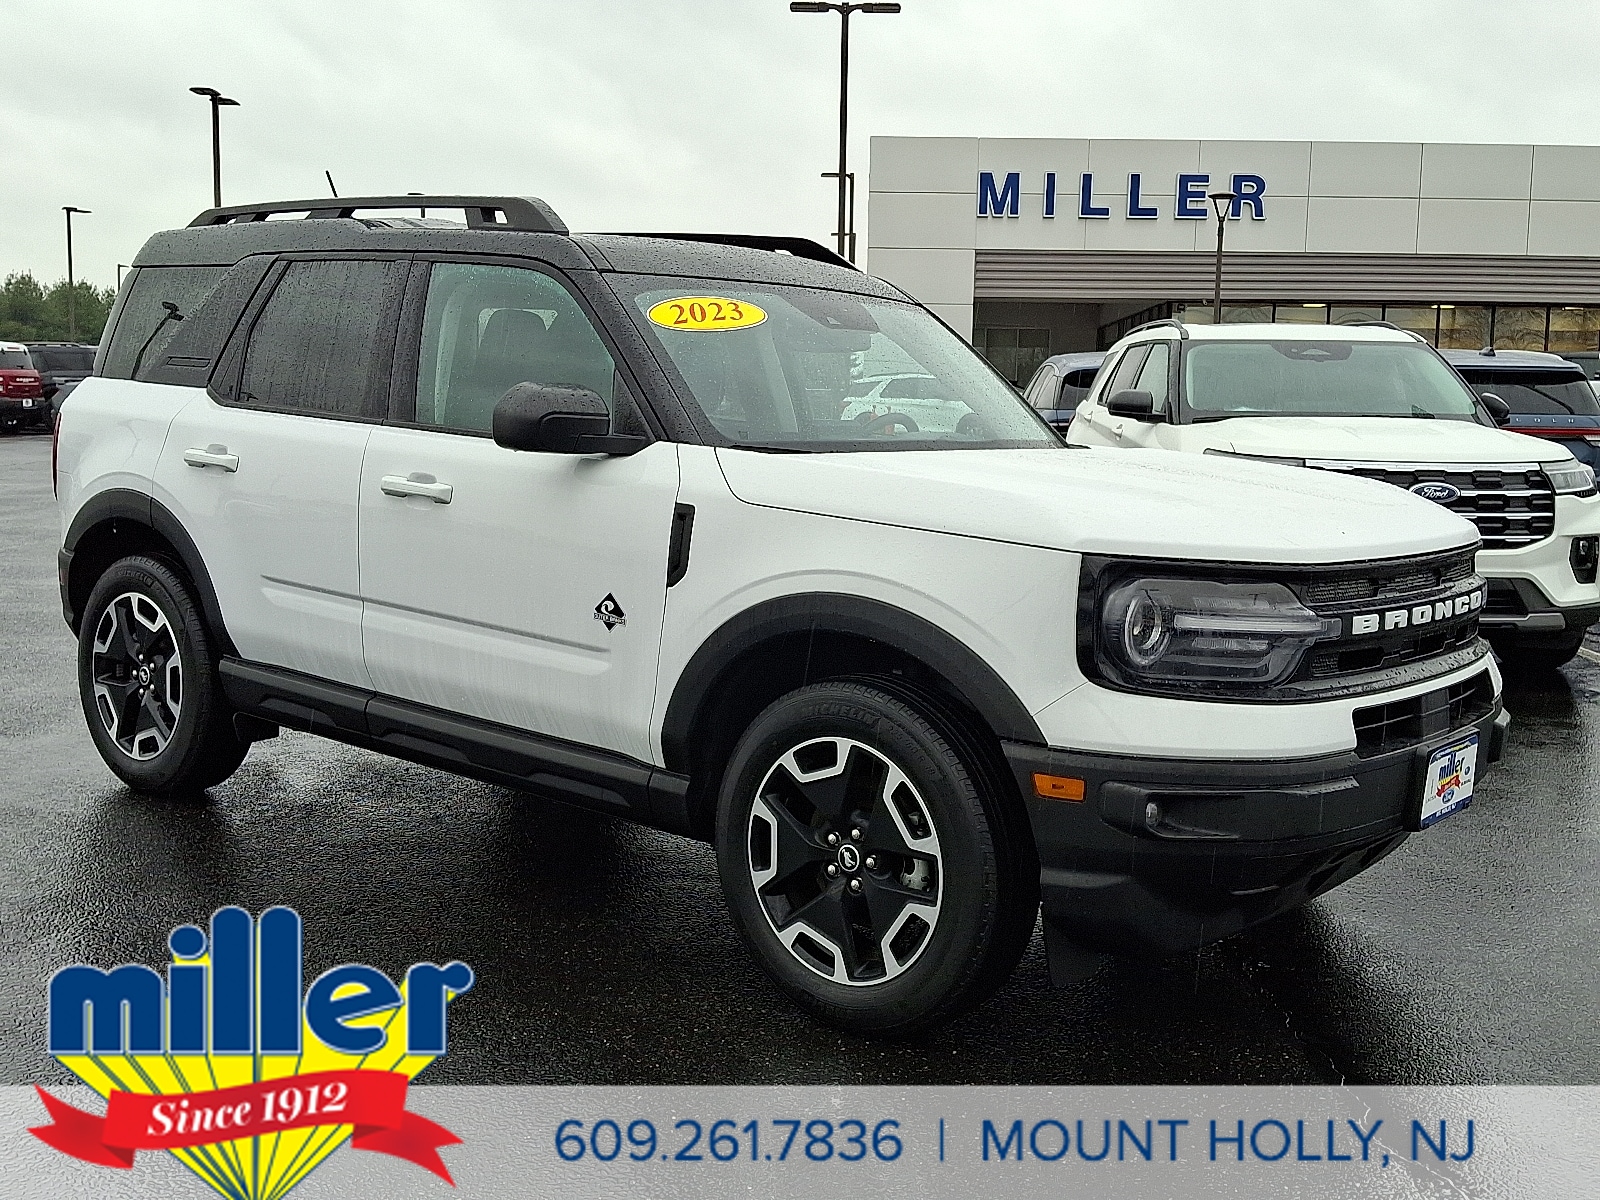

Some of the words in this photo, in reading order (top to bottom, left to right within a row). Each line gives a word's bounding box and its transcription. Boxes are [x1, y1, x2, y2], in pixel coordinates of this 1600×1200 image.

[977, 170, 1267, 220] MILLER
[669, 302, 744, 325] 2023
[1421, 486, 1449, 499] Ford
[1352, 590, 1482, 635] BRONCO
[1438, 751, 1466, 781] miller
